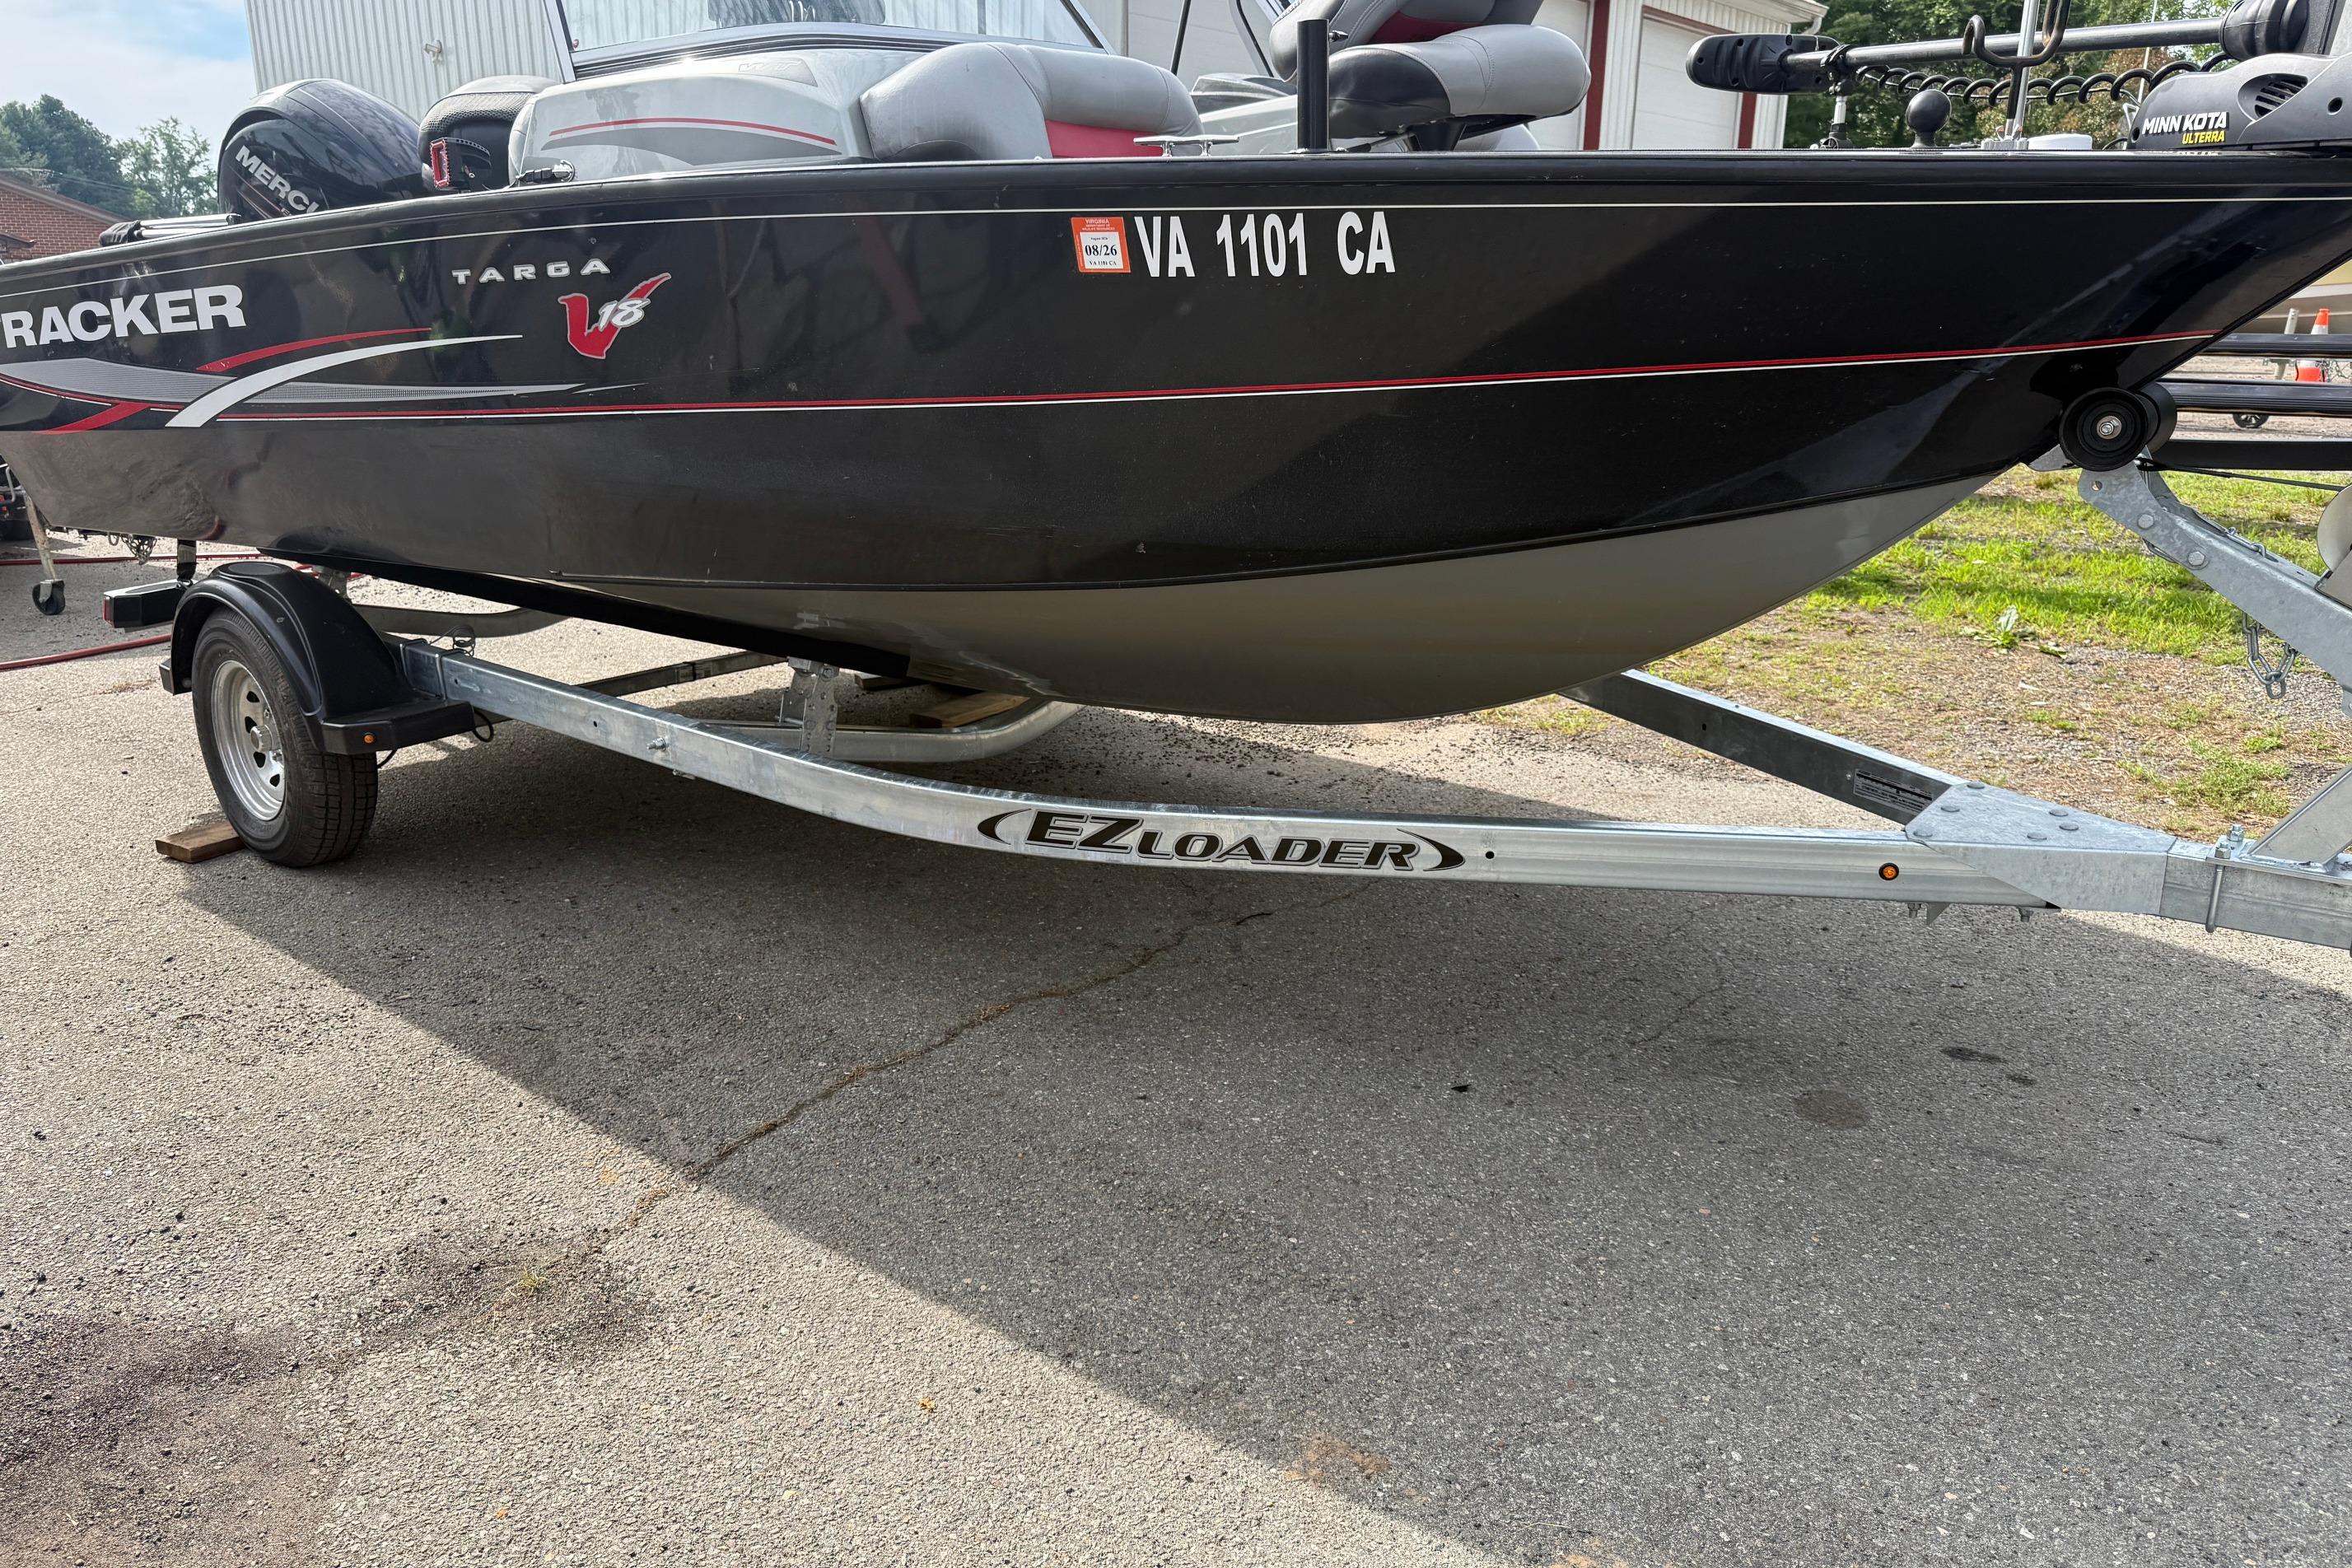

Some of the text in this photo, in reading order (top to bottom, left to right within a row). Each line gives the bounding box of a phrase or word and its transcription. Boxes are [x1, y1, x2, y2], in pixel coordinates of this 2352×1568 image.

[2141, 111, 2228, 135] MINN KOTA
[2182, 130, 2226, 145] ULTERRA
[1085, 245, 1118, 256] 08/26
[1134, 215, 1197, 278] VA
[1216, 212, 1308, 278] 1101
[1336, 210, 1396, 276] CA
[452, 258, 611, 285] TARGA
[0, 284, 247, 349] RACKER
